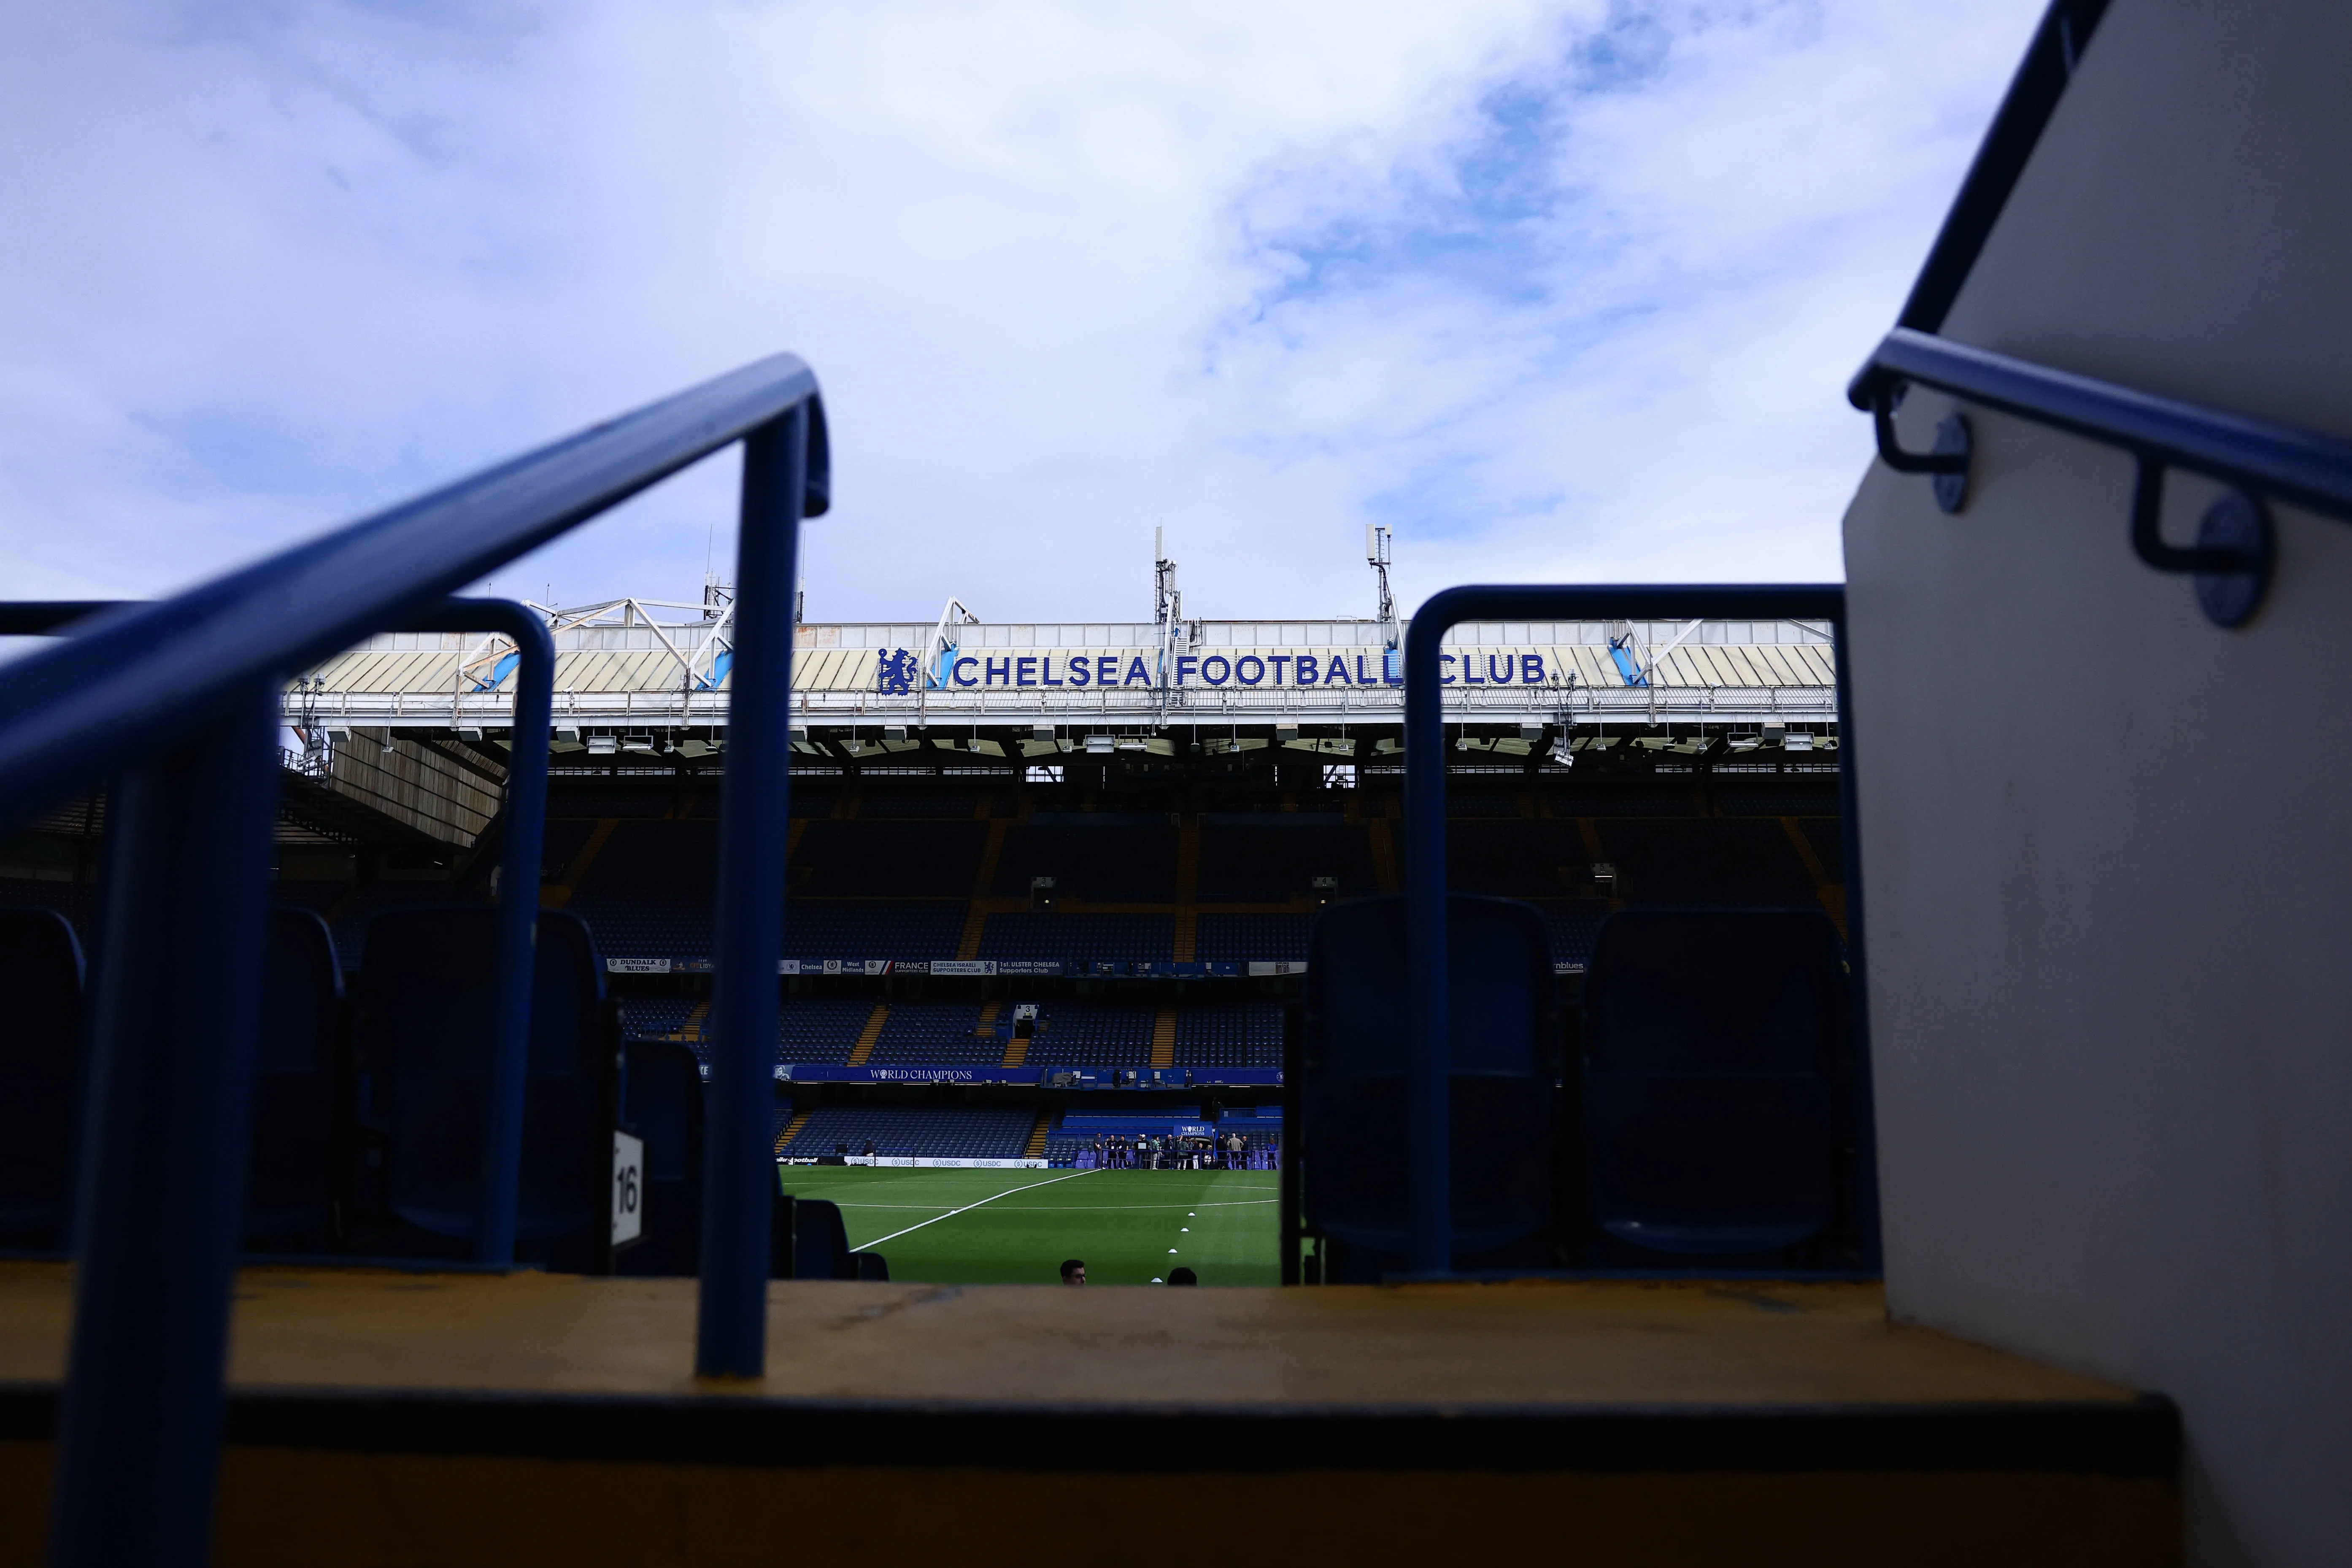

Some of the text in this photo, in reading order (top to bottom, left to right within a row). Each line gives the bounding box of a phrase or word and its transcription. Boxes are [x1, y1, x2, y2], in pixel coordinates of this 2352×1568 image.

[953, 654, 1545, 686] CHELSEA FOOTBALL CLUB
[870, 1069, 972, 1080] WORLD CHAMPIONS
[618, 1165, 637, 1214] 16
